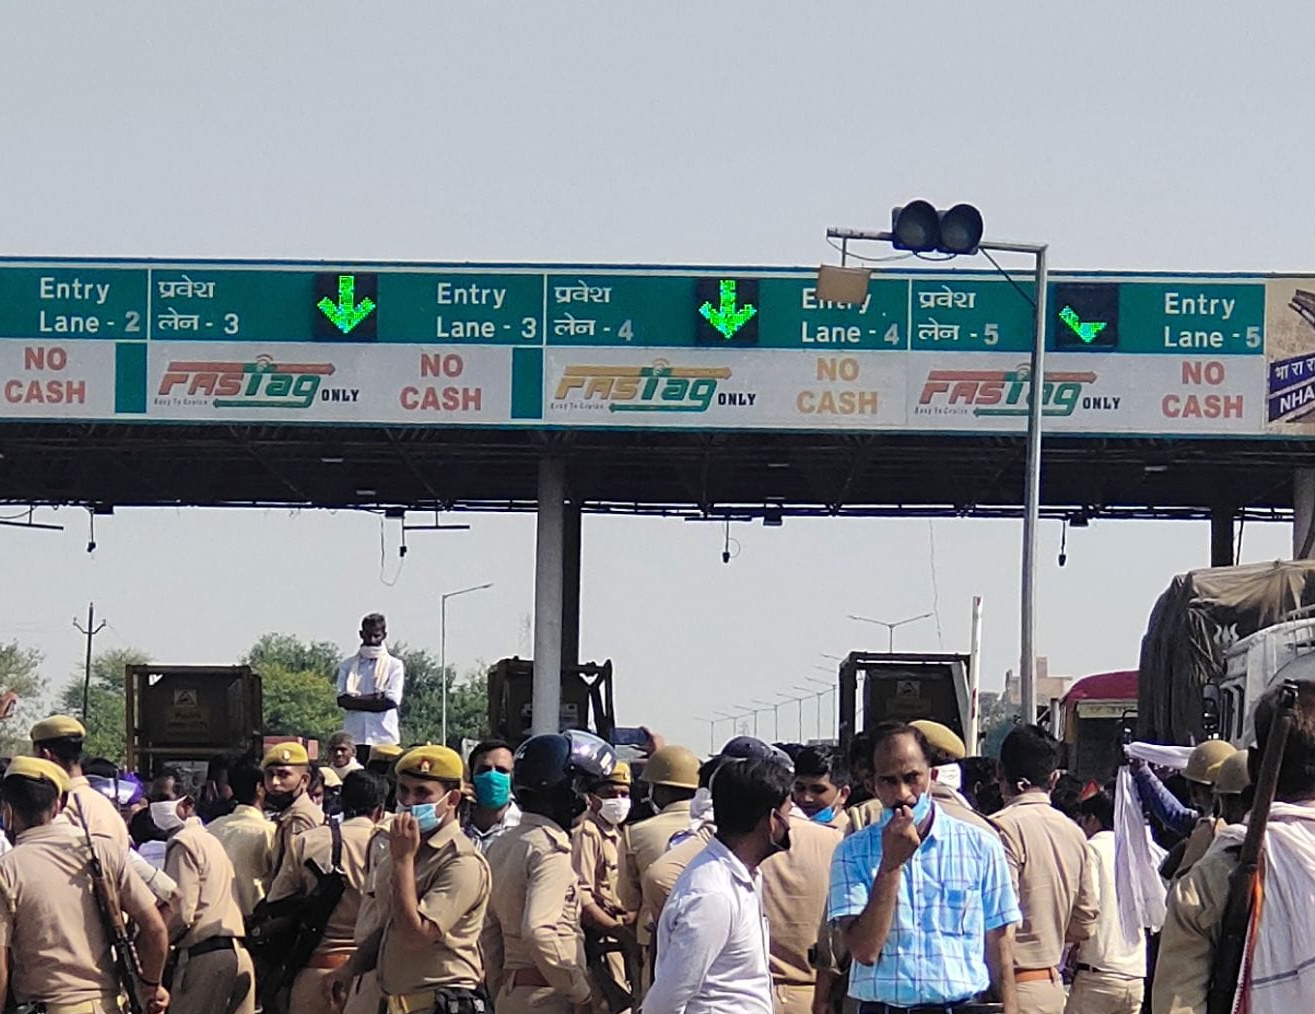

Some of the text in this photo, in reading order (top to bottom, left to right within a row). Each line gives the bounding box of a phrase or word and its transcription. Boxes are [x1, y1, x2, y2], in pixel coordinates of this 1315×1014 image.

[40, 277, 110, 304] Entry
[158, 274, 216, 298] प्रवेश
[437, 282, 506, 310] Entry
[554, 280, 612, 304] प्रवेश
[918, 285, 976, 308] प्रवेश
[1164, 292, 1236, 320] Entry
[40, 311, 100, 334] Lane
[124, 311, 140, 332] 2
[158, 307, 200, 330] लेन
[224, 313, 240, 334] 3
[436, 316, 496, 338] Lane
[521, 317, 536, 338] 3
[553, 312, 596, 336] लेन
[618, 319, 634, 342] 4
[918, 317, 960, 340] लेन
[984, 323, 998, 346] 5
[801, 321, 860, 342] Lane
[884, 323, 900, 346] 4
[1164, 326, 1224, 348] Lane
[1246, 326, 1262, 348] 5
[24, 347, 68, 370] NO
[421, 353, 464, 378] NO
[816, 357, 860, 382] NO
[1182, 361, 1226, 386] NO
[4, 379, 86, 404] CASH
[321, 389, 360, 402] ONLY
[400, 386, 482, 412] CASH
[718, 393, 756, 406] ONLY
[796, 390, 878, 416] CASH
[1083, 397, 1120, 410] ONLY
[1162, 394, 1244, 418] CASH
